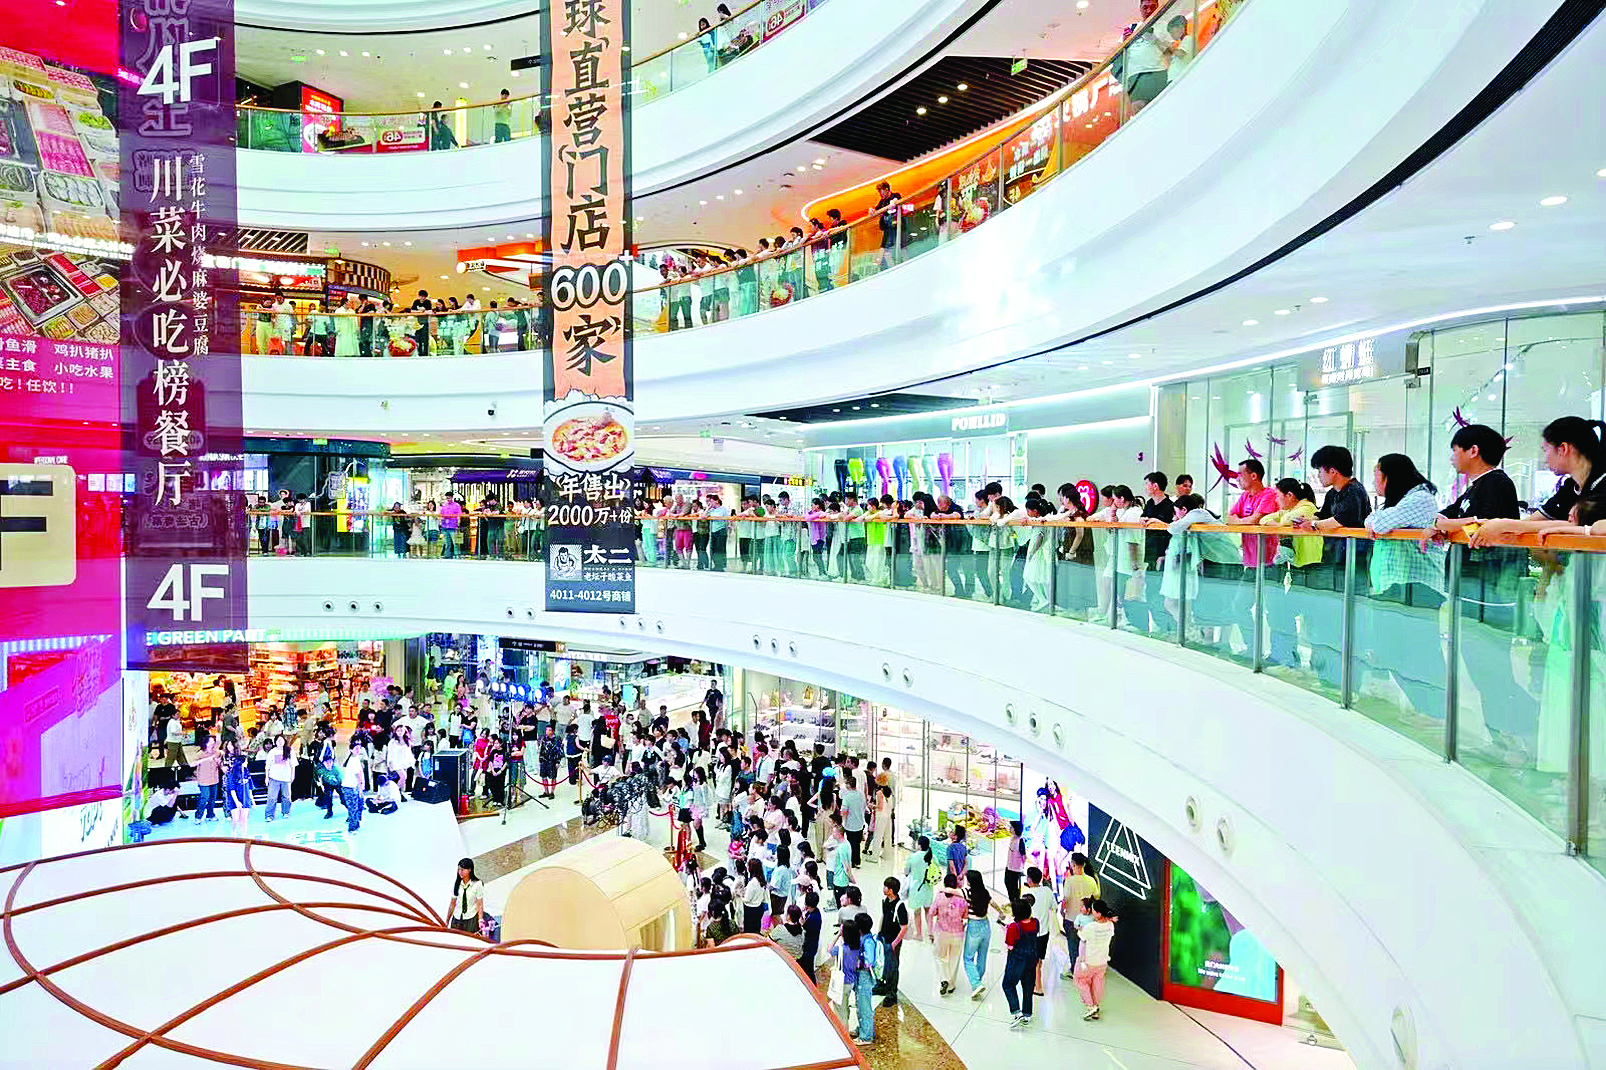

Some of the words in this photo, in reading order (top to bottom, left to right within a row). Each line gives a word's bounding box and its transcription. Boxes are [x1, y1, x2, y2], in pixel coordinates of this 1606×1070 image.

[137, 37, 217, 105] 4F
[558, 0, 613, 254] 球直营门店
[0, 337, 37, 354] 鱼滑
[54, 343, 114, 361] 鸡扒猪扒
[149, 156, 192, 506] 川菜必吃榜餐厅
[563, 315, 621, 377] 家
[0, 357, 37, 372] 主食
[54, 361, 114, 379] 小吃水果
[558, 473, 627, 503] 年售出
[583, 544, 633, 565] 太二
[147, 563, 229, 622] 4F
[158, 631, 220, 646] GREEN
